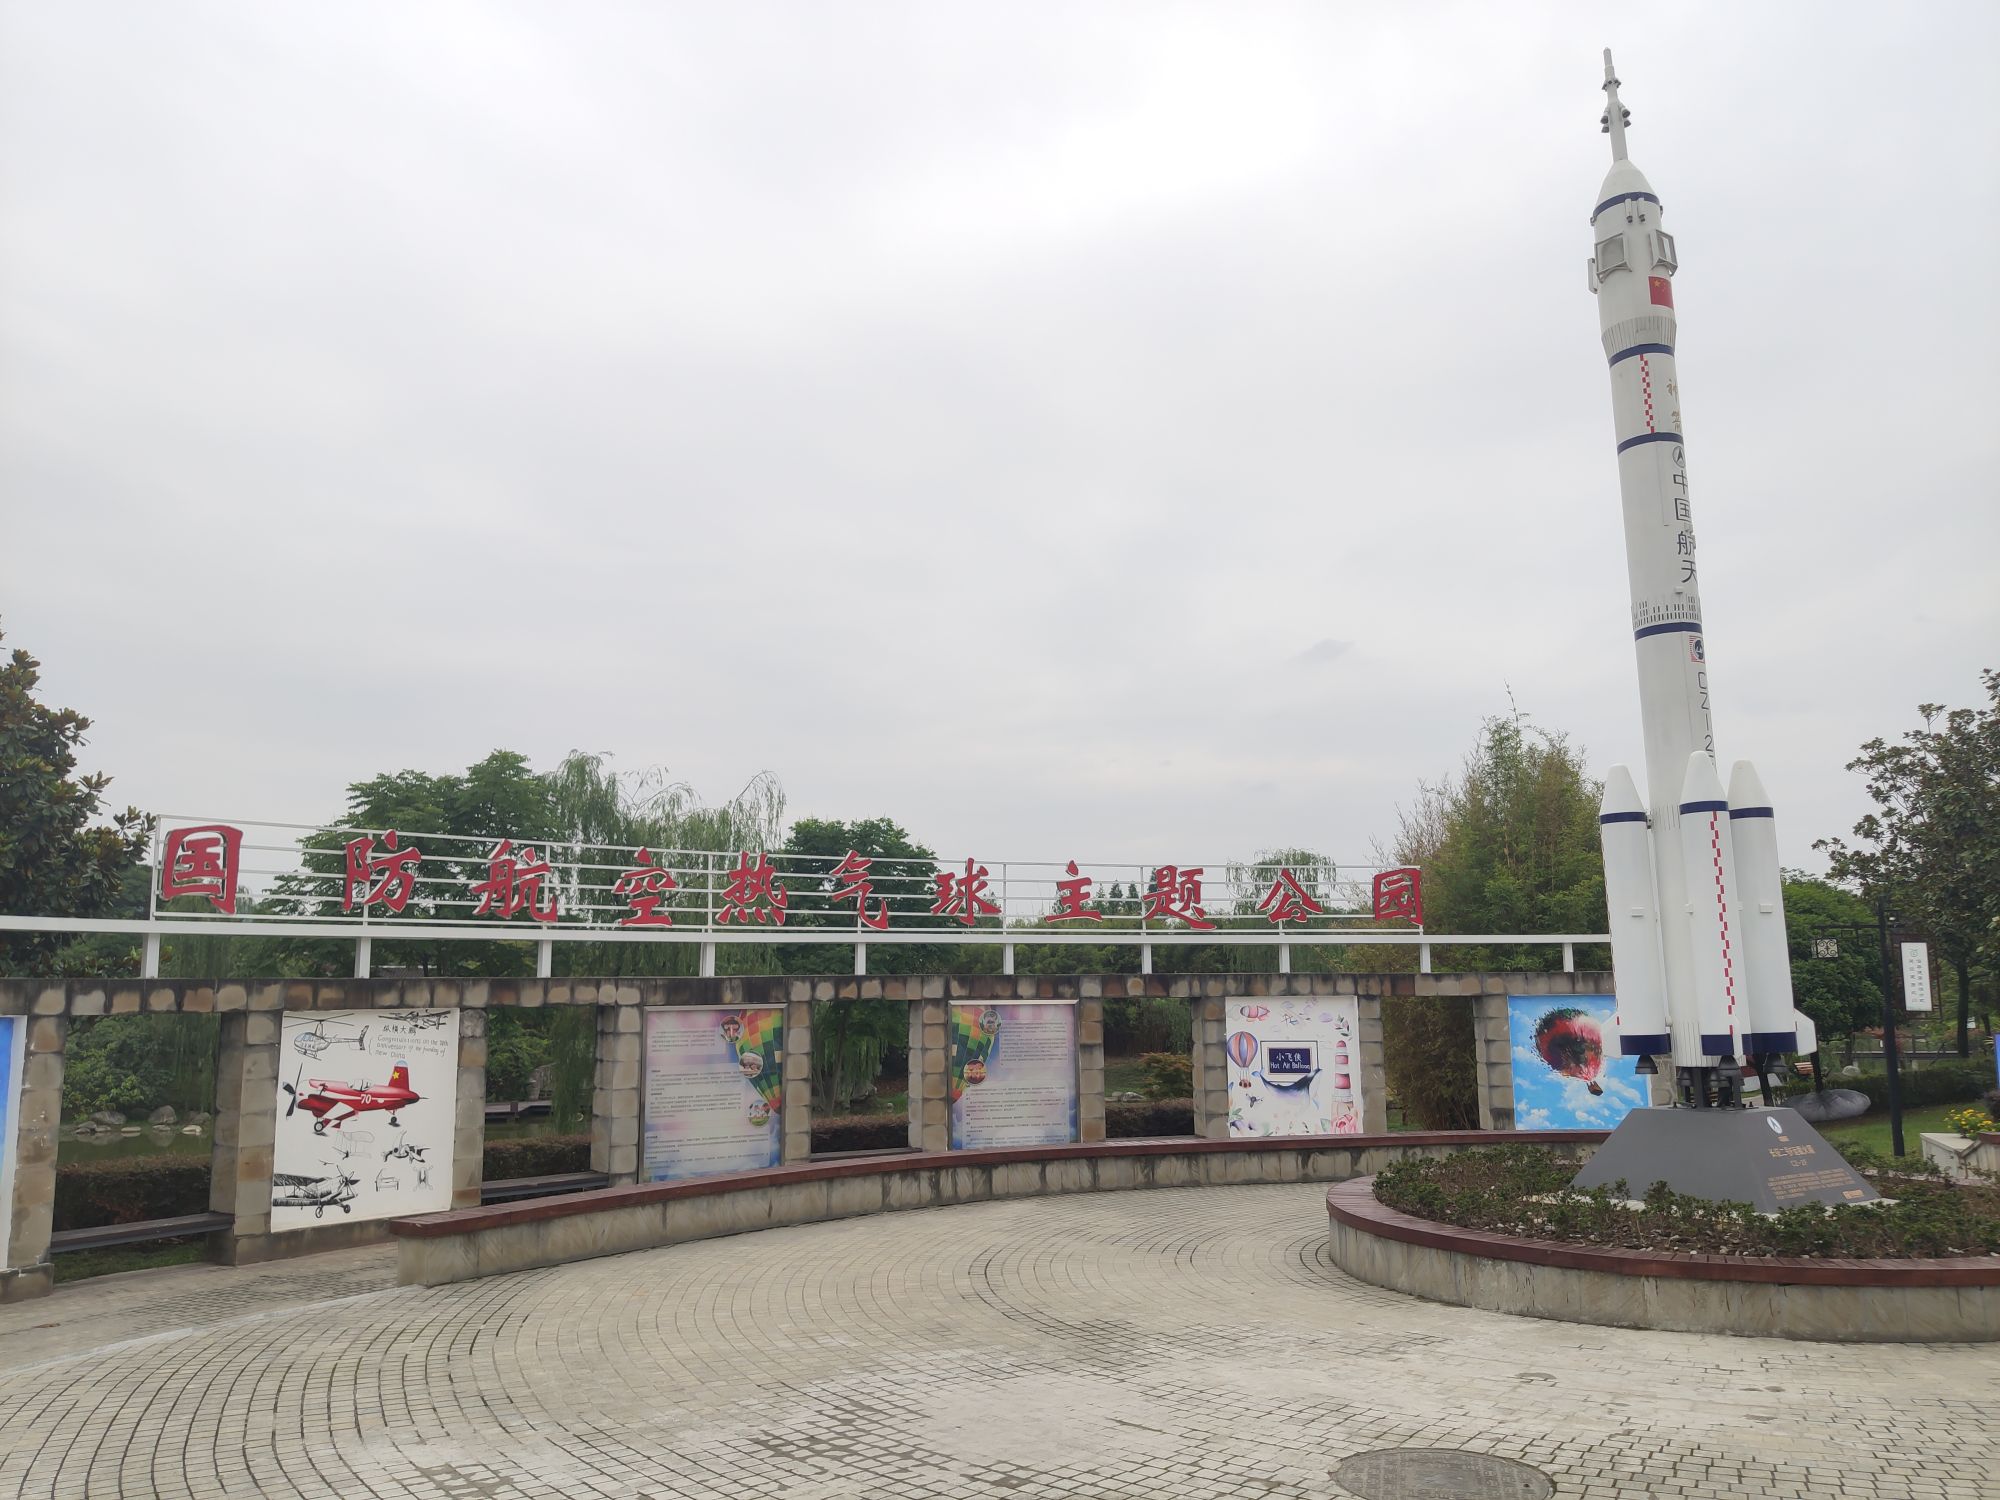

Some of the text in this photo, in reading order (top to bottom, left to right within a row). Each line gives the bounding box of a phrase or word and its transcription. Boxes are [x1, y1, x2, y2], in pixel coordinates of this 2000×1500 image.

[1673, 469, 1697, 583] 中国航天
[160, 824, 1424, 931] 国防航空热气球主题公园
[1276, 1052, 1302, 1062] 小飞侠
[360, 1093, 372, 1105] 70
